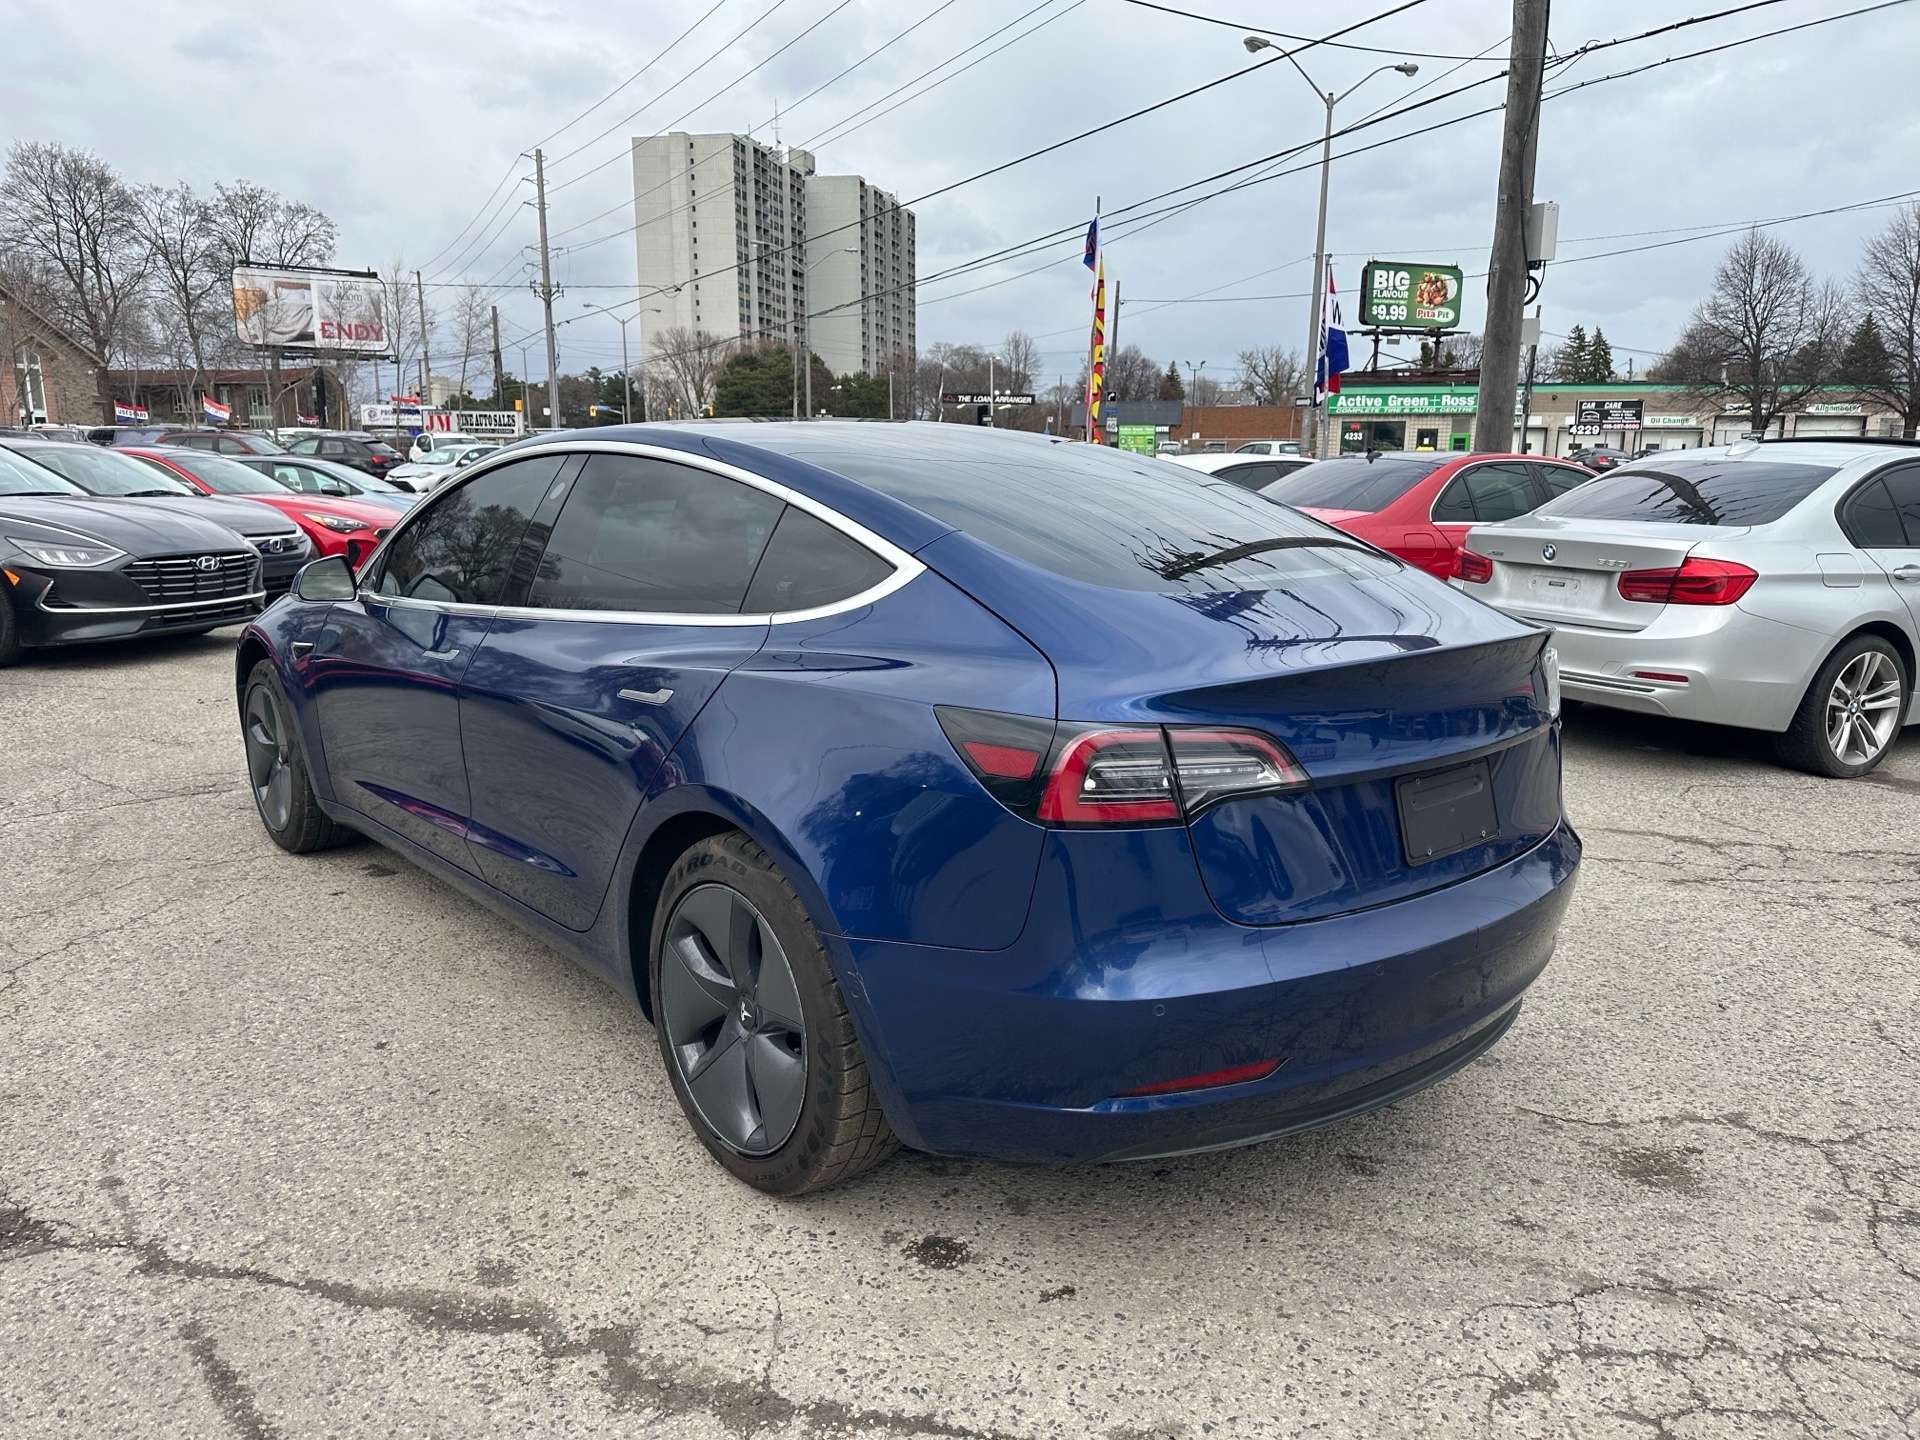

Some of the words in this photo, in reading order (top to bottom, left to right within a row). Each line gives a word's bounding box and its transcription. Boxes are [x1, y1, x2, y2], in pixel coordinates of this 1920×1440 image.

[1374, 270, 1410, 291] BIG
[1372, 289, 1409, 299] FLAVOUR
[1371, 304, 1408, 321] $9.99
[1416, 309, 1436, 319] Pita
[1437, 311, 1450, 319] Pit
[320, 321, 384, 342] ENDY
[958, 395, 971, 403] THE
[995, 396, 1032, 404] ARRANGER
[1337, 395, 1382, 407] Active
[425, 415, 452, 432] JM
[475, 414, 492, 428] AUTO
[494, 414, 516, 428] SALES
[1663, 417, 1690, 426] Change
[1569, 425, 1600, 435] 4229
[1344, 432, 1363, 441] 4233
